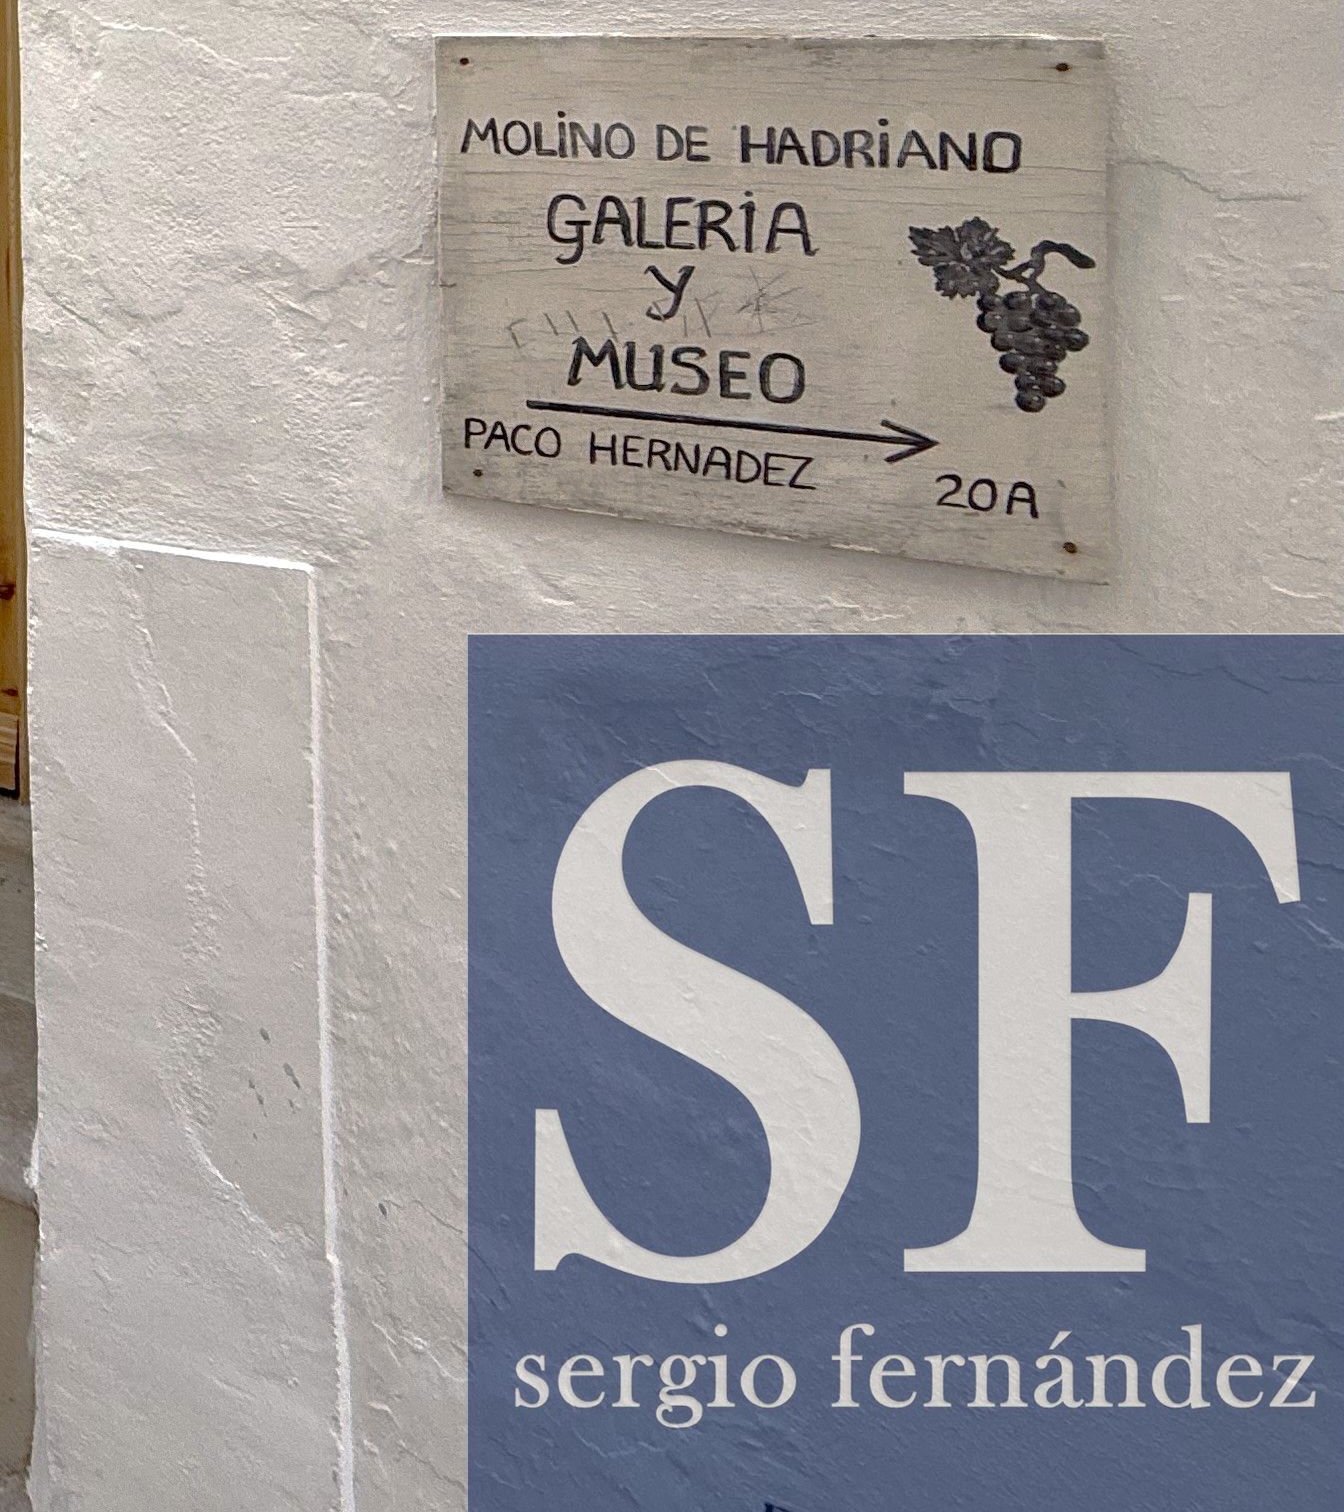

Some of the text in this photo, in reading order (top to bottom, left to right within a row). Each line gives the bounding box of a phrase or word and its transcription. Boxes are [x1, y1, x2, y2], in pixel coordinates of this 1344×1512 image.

[656, 125, 712, 162] DE
[567, 337, 807, 405] MUSEO
[464, 418, 816, 490] PACO HERNADEZ
[935, 474, 1040, 519] 20A
